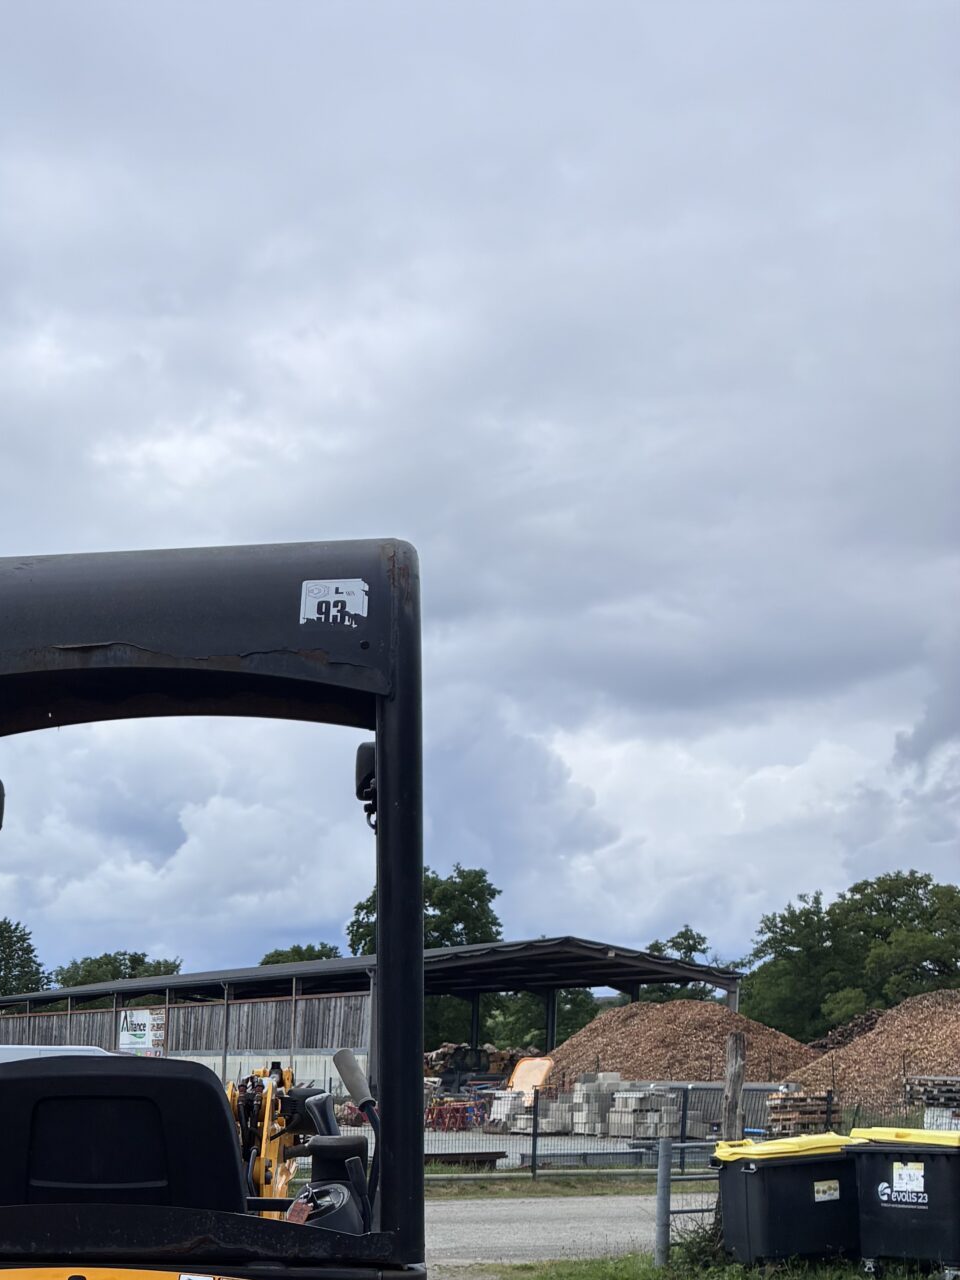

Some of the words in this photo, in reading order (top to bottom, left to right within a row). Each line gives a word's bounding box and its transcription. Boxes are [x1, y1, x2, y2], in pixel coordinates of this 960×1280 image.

[335, 586, 344, 595] L
[316, 600, 347, 622] 93
[917, 1192, 928, 1203] 23
